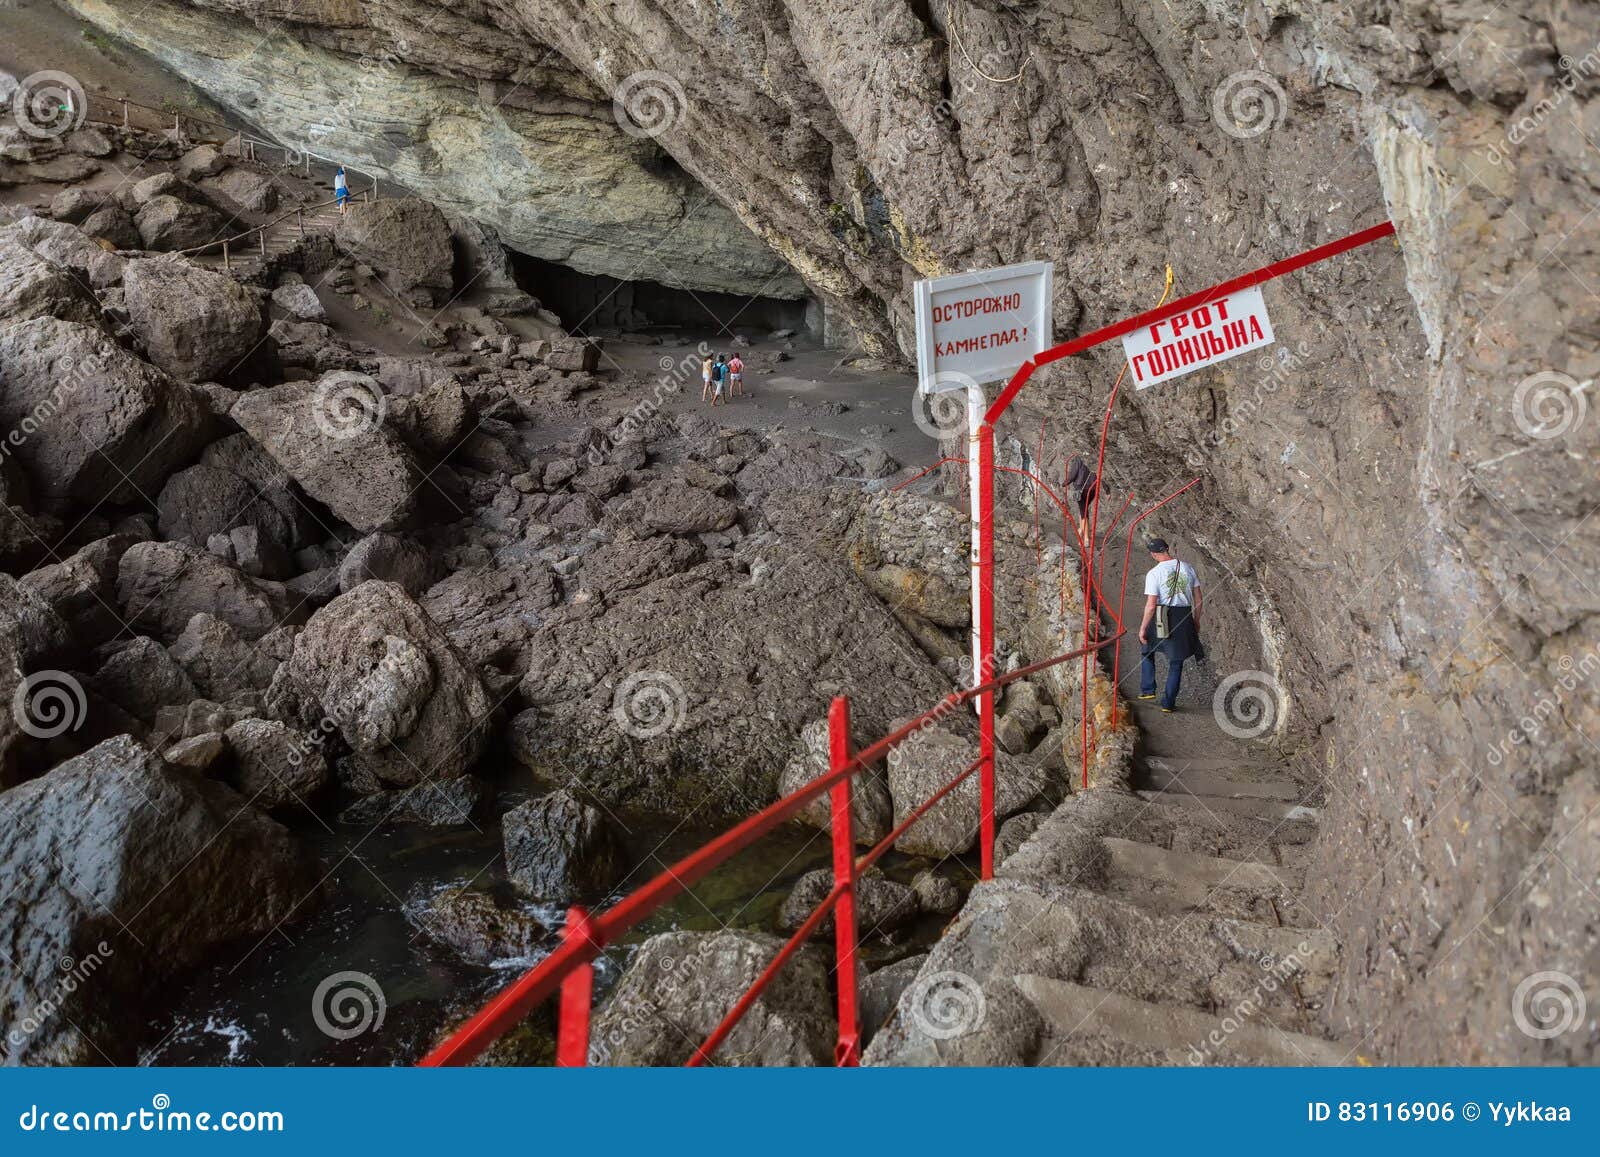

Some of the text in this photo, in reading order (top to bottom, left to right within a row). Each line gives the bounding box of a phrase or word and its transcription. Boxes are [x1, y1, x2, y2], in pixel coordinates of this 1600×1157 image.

[932, 292, 1021, 324] ОСТОРОЖНО
[1148, 298, 1230, 345] ГРОТ
[935, 327, 1028, 358] КАМНЕПАД!
[1132, 314, 1265, 382] ГОЛИЦЫНА
